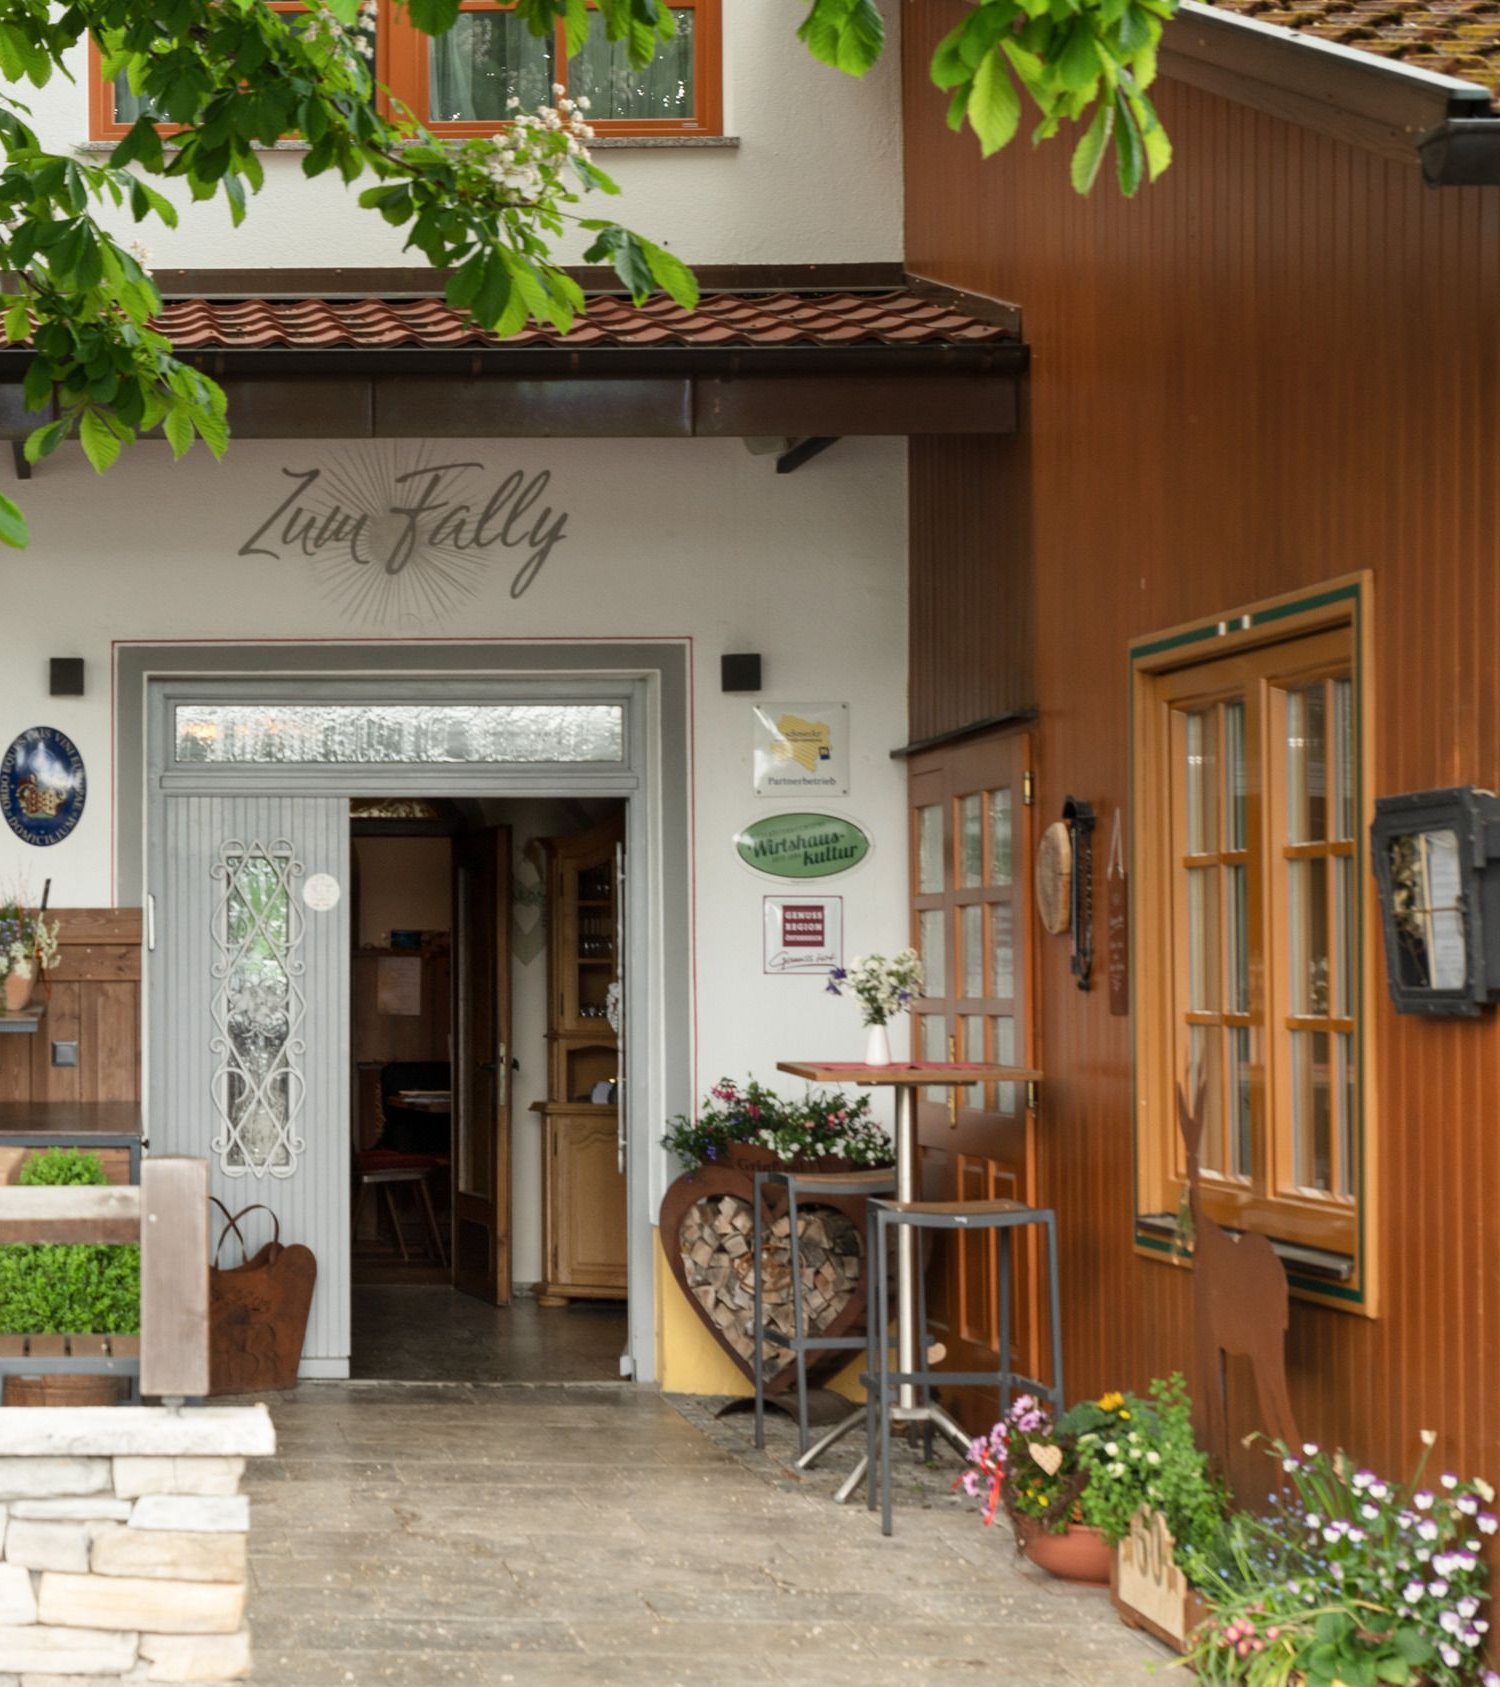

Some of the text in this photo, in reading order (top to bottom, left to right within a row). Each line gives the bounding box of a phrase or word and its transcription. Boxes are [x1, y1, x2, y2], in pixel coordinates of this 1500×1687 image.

[237, 463, 569, 599] Zum Fally
[768, 776, 836, 785] Partnerbetrieb
[749, 833, 845, 858] Wirtshaus-
[803, 845, 858, 866] kultur
